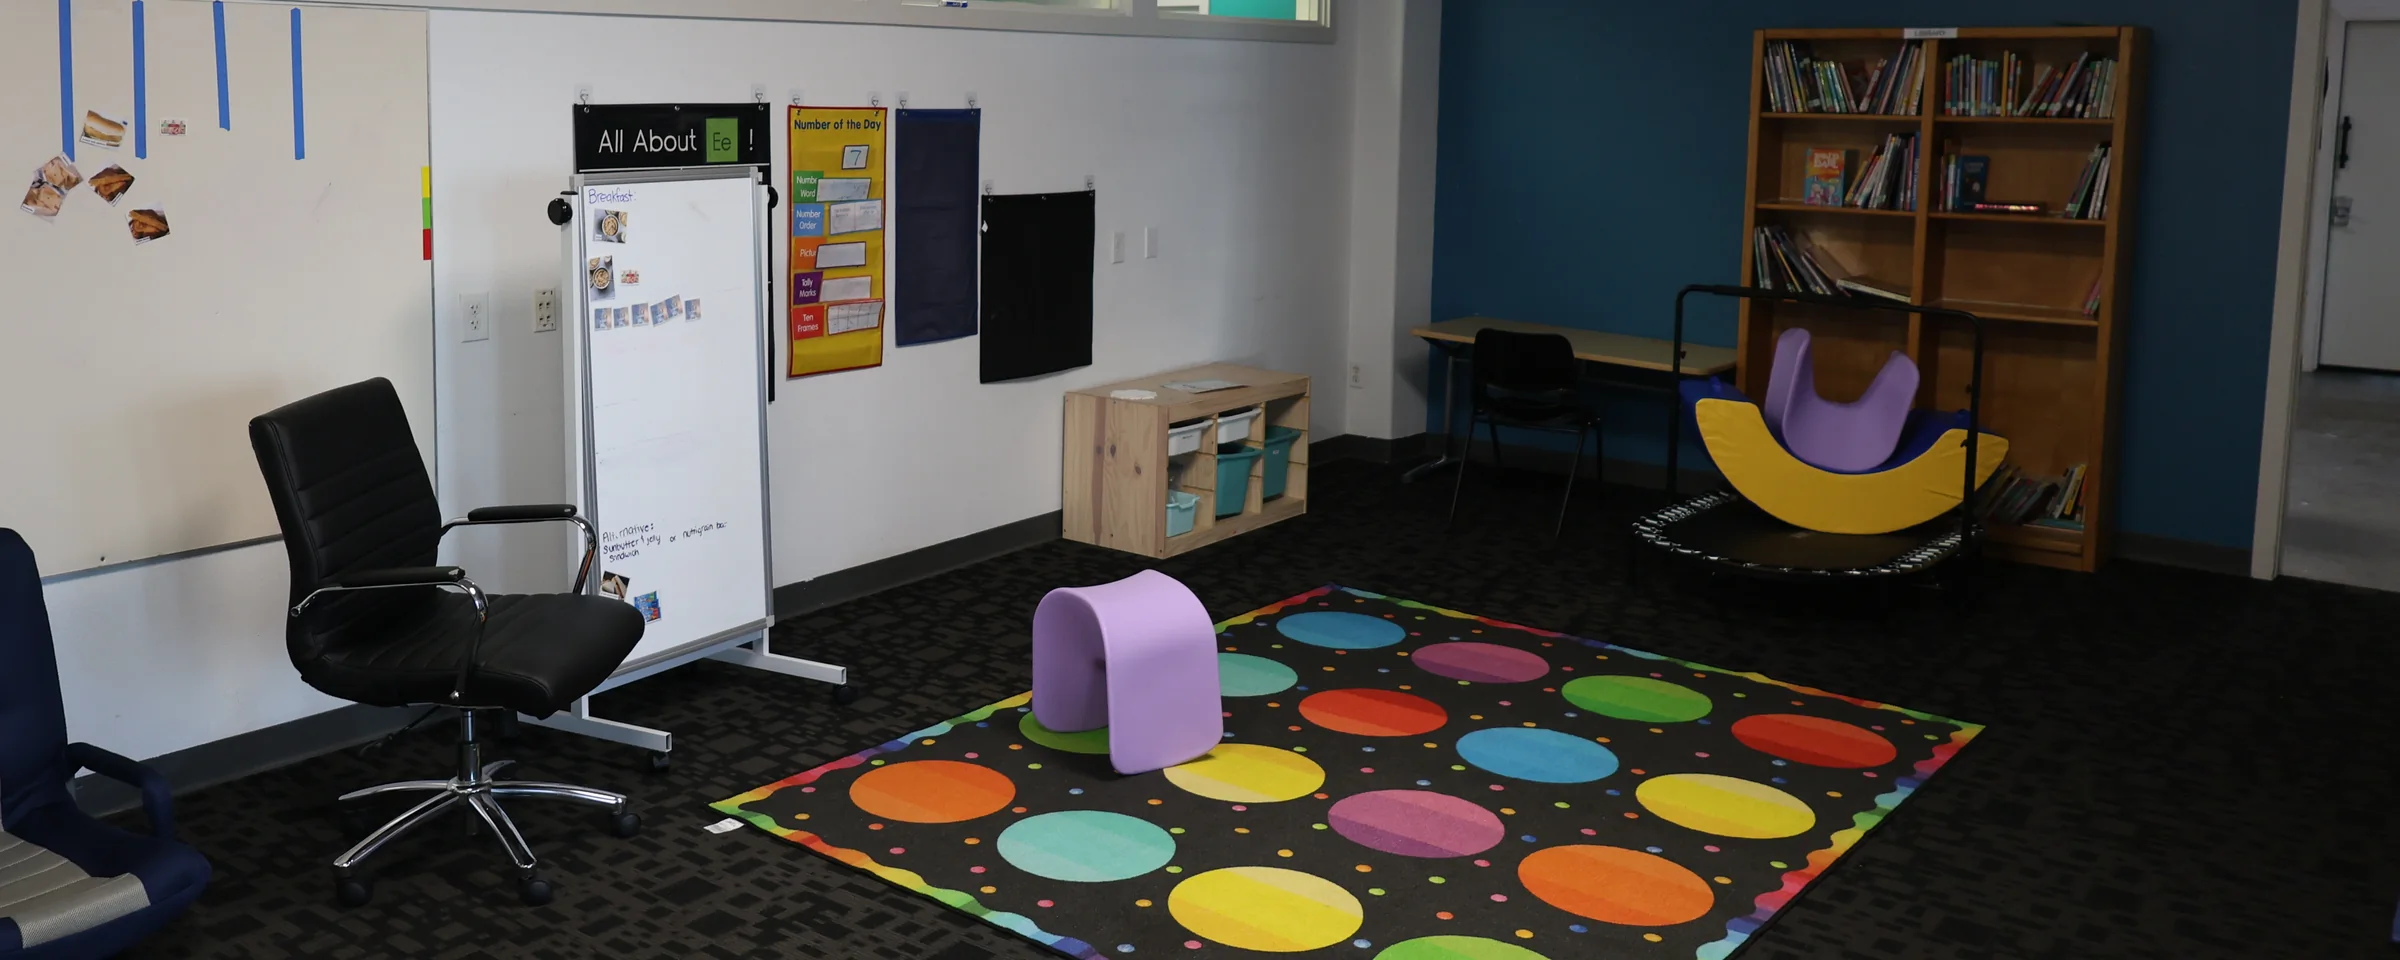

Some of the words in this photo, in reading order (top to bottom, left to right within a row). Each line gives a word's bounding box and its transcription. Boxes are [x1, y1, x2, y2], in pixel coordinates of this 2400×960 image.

[794, 119, 831, 130] Number
[834, 118, 844, 130] of
[847, 119, 861, 129] the
[864, 119, 881, 132] Day
[598, 129, 624, 153] All
[633, 128, 697, 153] About
[712, 132, 732, 151] Ee
[850, 149, 862, 166] 7
[796, 175, 818, 185] Numb
[588, 187, 637, 204] Breakfast:
[800, 189, 817, 198] Word
[796, 209, 821, 218] Number
[799, 221, 818, 230] Order
[800, 248, 817, 257] Pictu
[801, 278, 813, 288] Tally
[799, 289, 817, 298] Marks
[803, 313, 814, 322] Ten
[797, 323, 819, 332] Frames
[602, 522, 654, 543] Altrnative:
[669, 535, 677, 543] or
